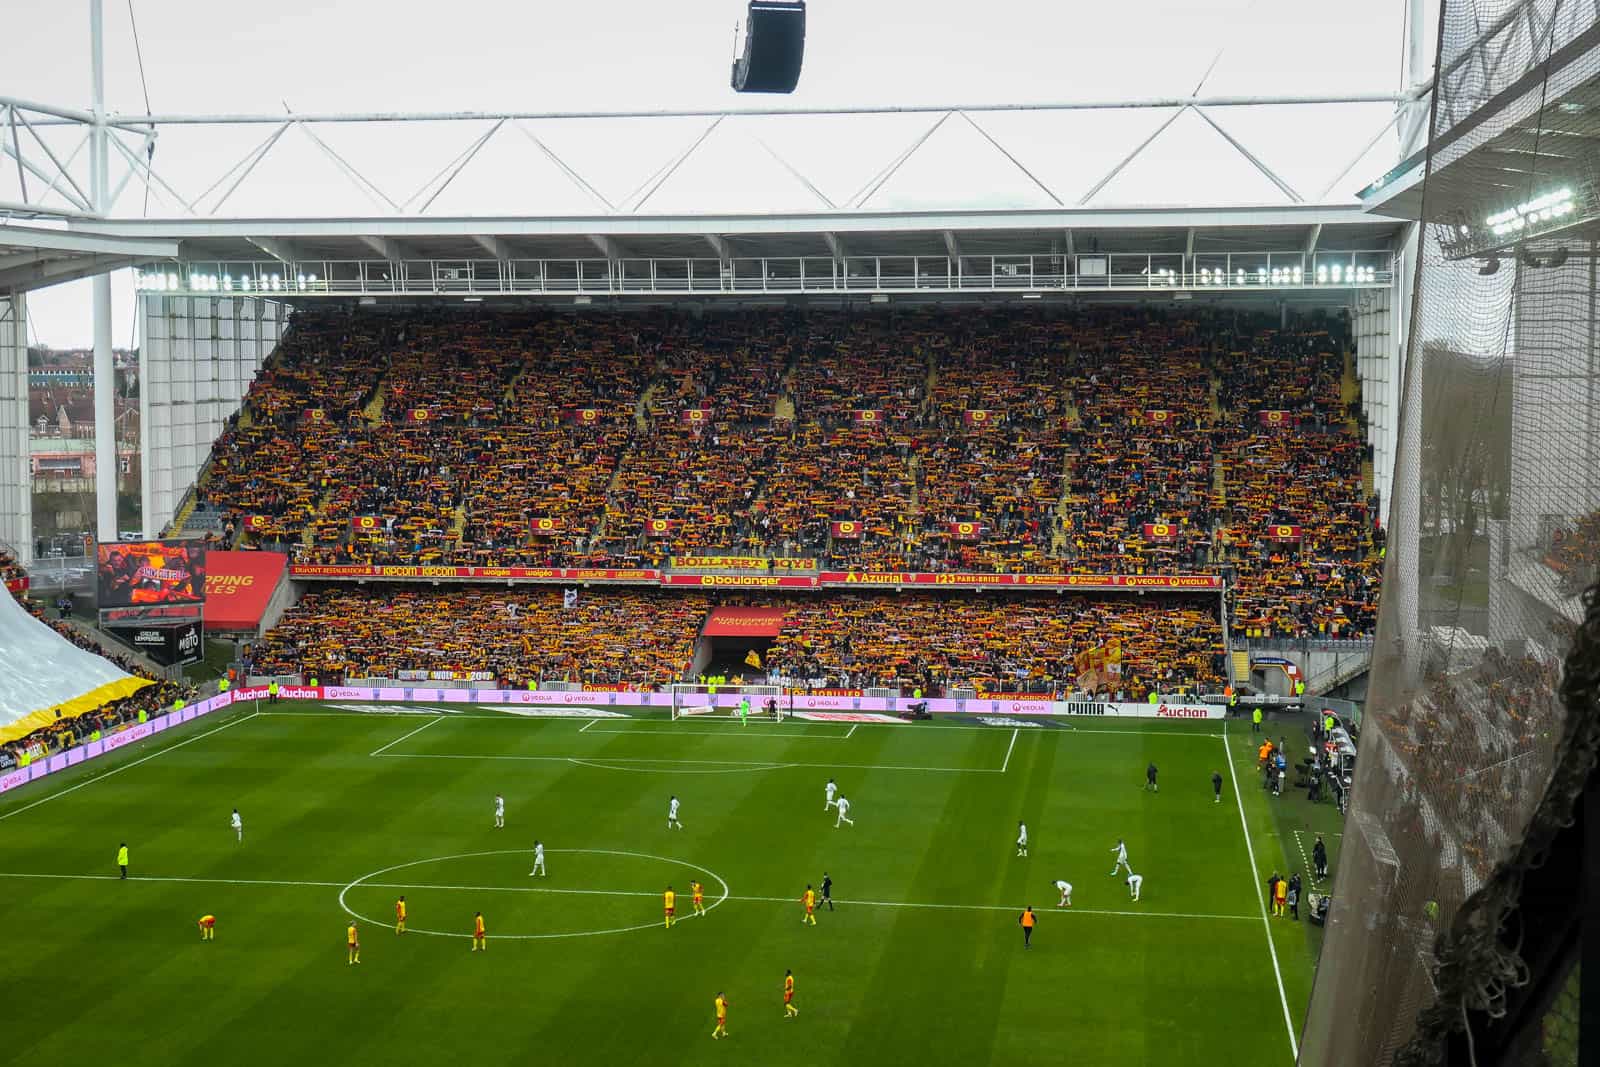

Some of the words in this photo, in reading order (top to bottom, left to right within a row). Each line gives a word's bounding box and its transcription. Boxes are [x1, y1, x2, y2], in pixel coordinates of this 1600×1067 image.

[716, 576, 780, 586] boulanger
[1137, 578, 1165, 586] VEOLIA
[1181, 578, 1208, 586] VEOLIA
[278, 686, 318, 698] Auchan
[1068, 702, 1104, 715] PUMA
[1158, 704, 1208, 718] Auchan
